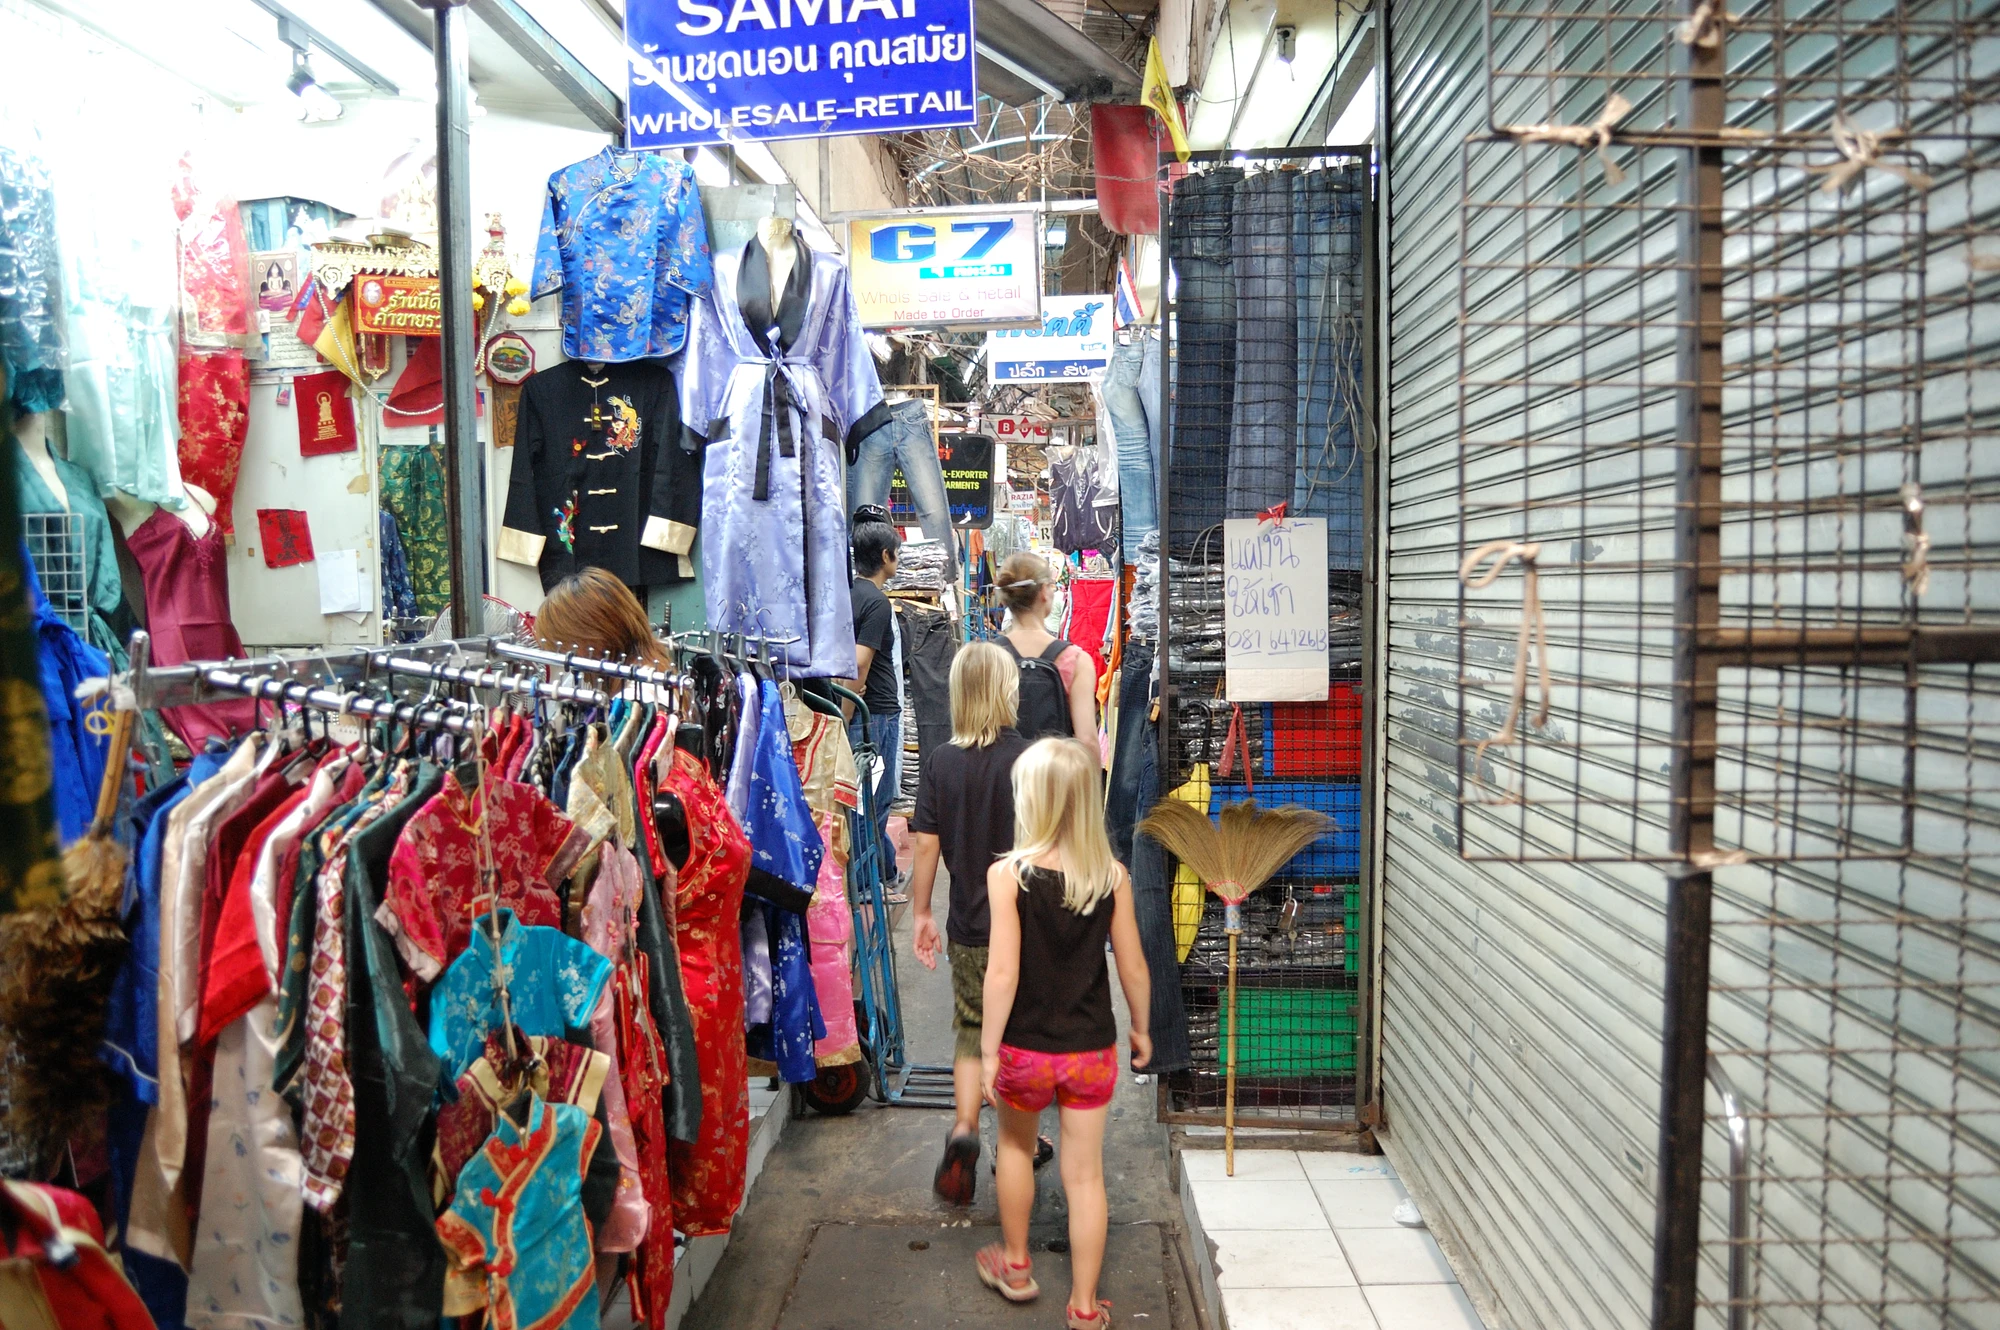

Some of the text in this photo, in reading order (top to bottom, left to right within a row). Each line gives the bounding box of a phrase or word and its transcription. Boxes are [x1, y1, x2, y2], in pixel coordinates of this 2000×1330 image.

[632, 24, 967, 94] ร้านชุดนอน คุณสมัย
[372, 304, 442, 329] ค้าขายร
[894, 307, 985, 321] Made to Order
[1008, 361, 1045, 378] ปลีก
[943, 480, 981, 491] ARMENTS
[1011, 493, 1034, 501] RAZIA
[1227, 572, 1295, 618] ให้เช่า
